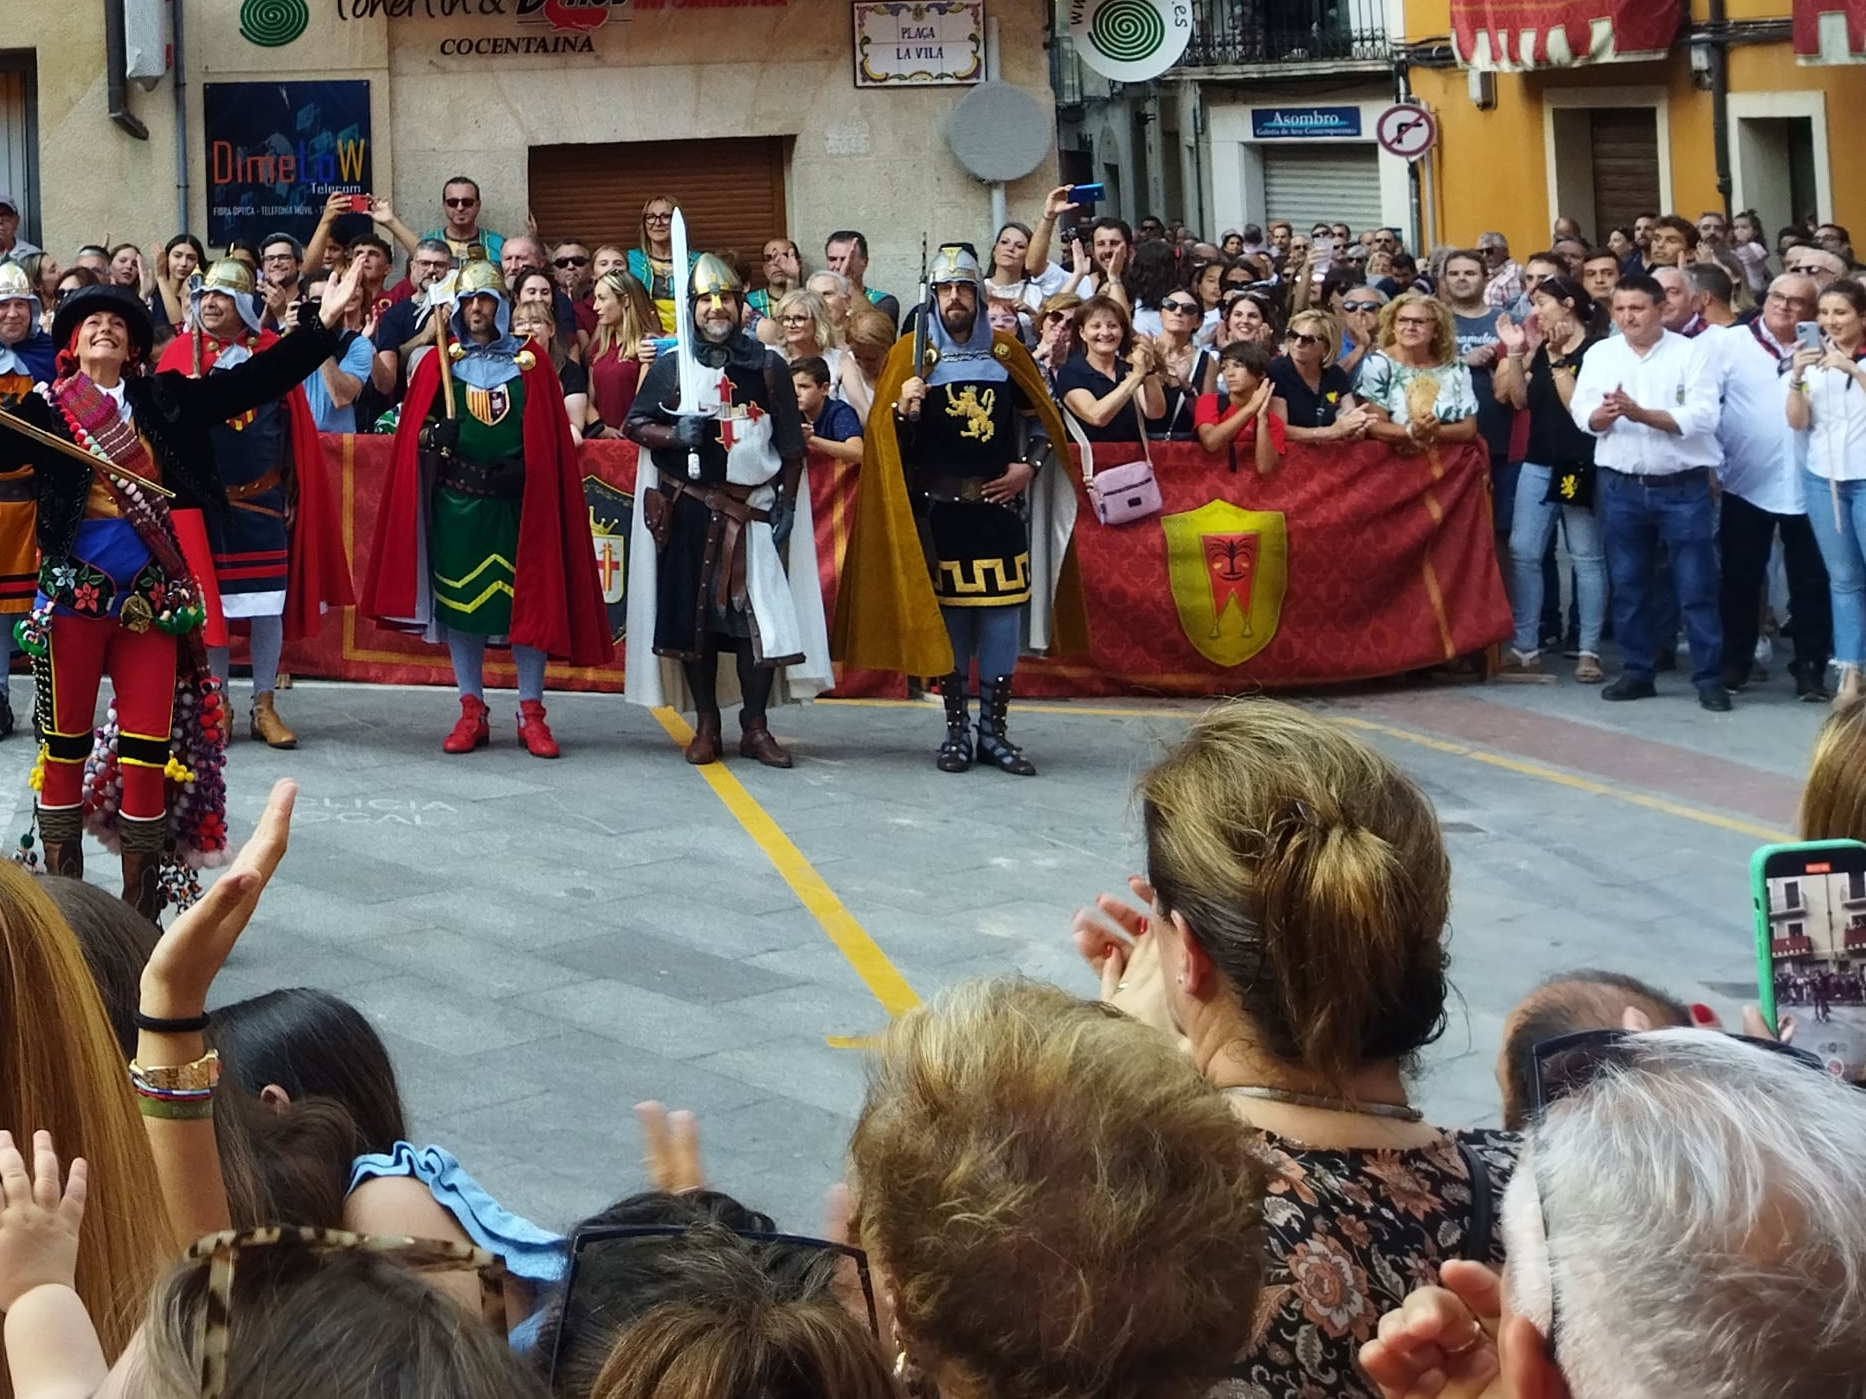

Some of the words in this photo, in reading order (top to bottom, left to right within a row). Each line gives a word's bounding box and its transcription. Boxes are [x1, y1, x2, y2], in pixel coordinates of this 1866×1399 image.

[901, 26, 936, 40] PLAÇA
[440, 34, 597, 56] COCENTAINA
[896, 47, 911, 60] LA
[915, 46, 944, 59] VILA
[1273, 109, 1340, 125] Asombro
[311, 182, 362, 195] Telecom
